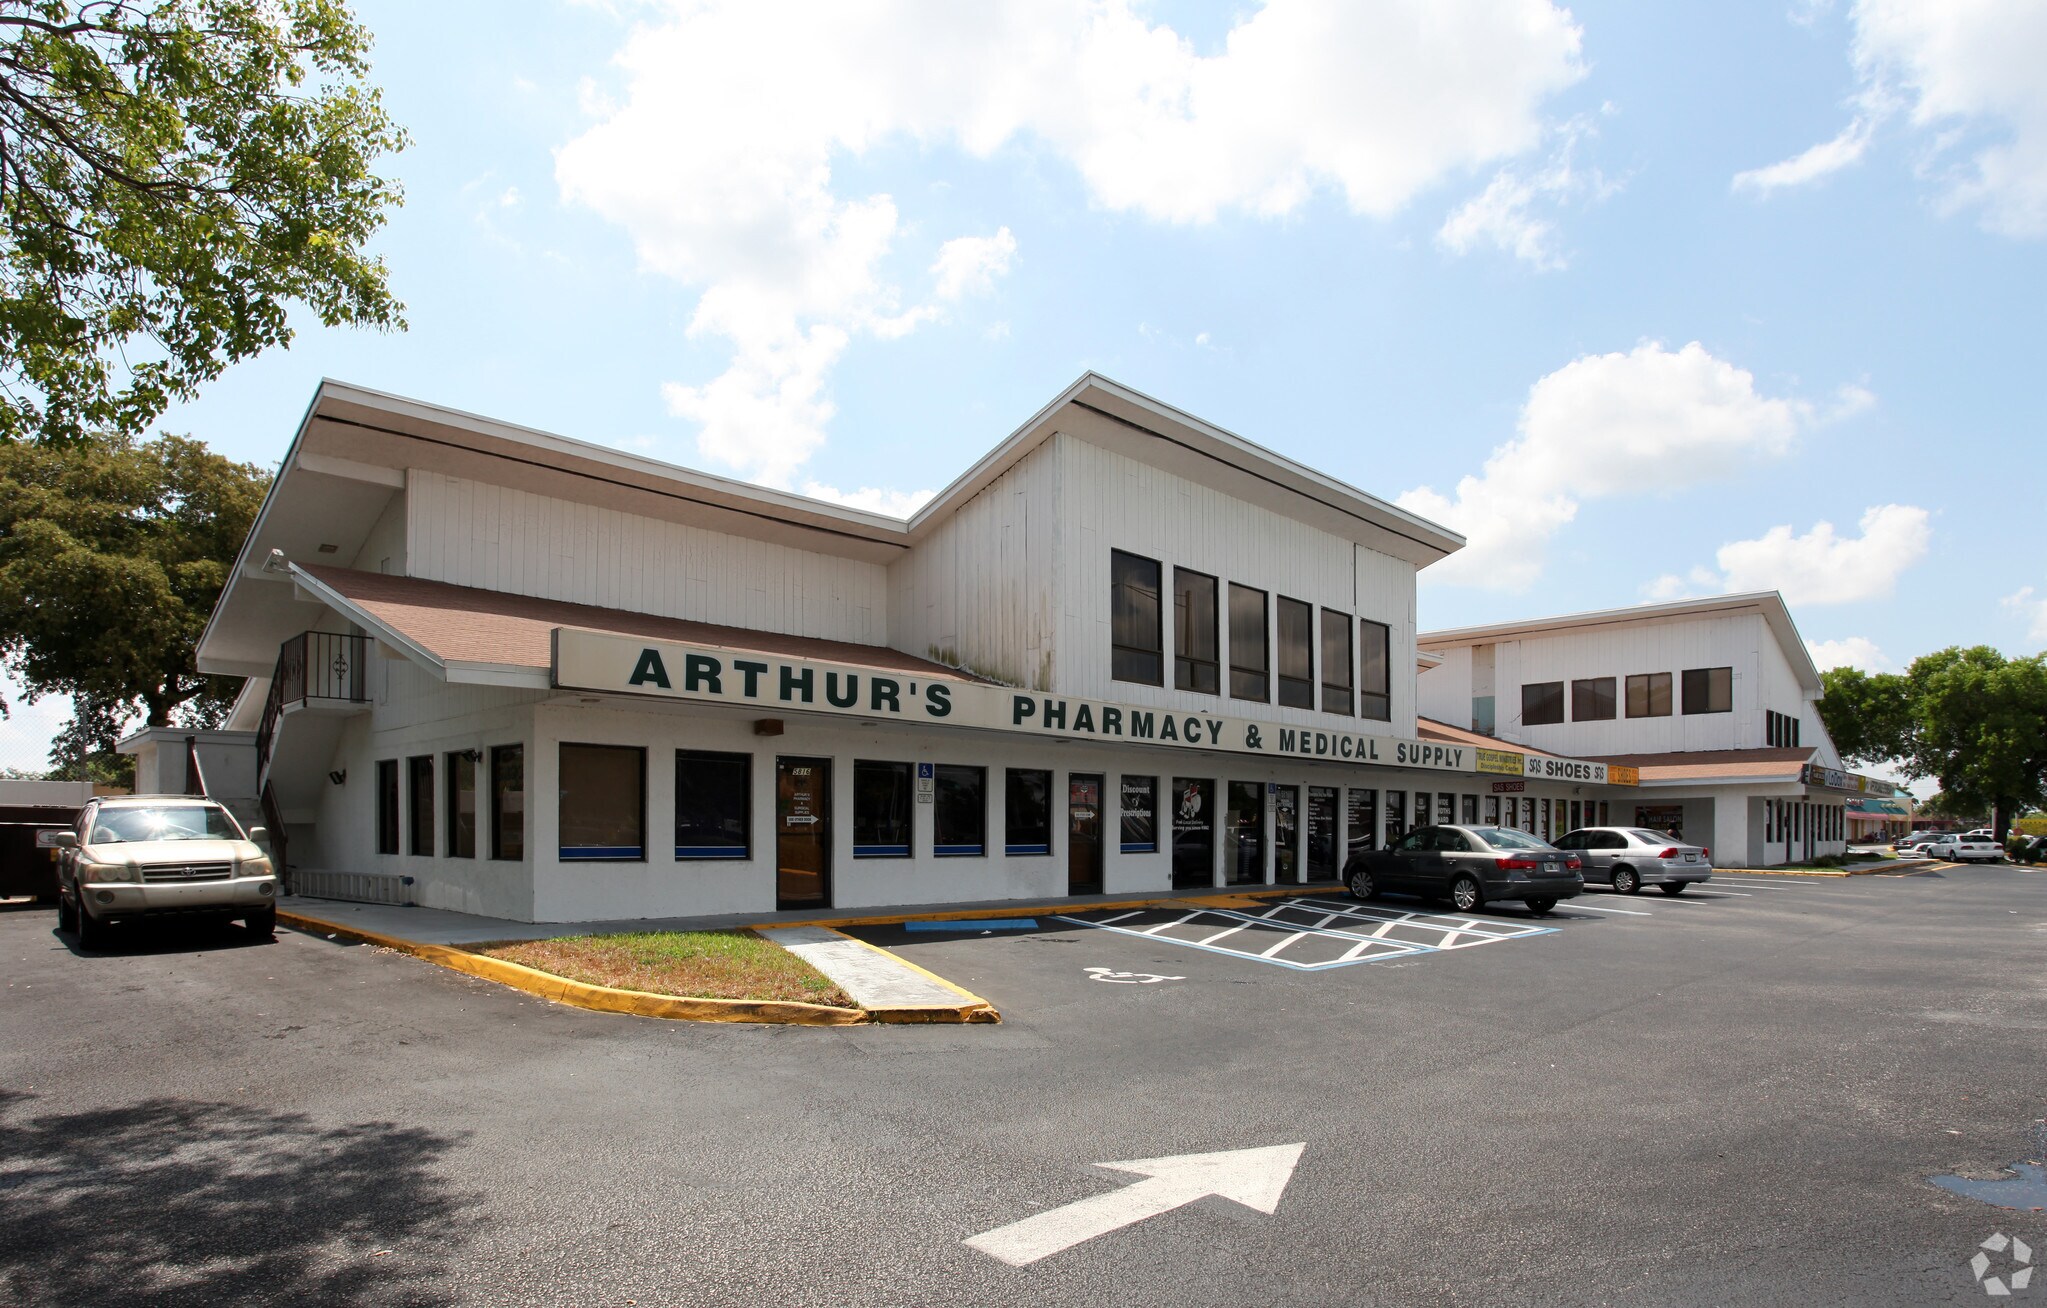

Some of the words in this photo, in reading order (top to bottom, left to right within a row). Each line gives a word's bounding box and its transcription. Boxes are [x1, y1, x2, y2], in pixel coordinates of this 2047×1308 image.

[628, 647, 953, 718] ARTHUR'S
[1012, 695, 1224, 746] PHARMACY
[1245, 724, 1263, 750] &
[1278, 728, 1380, 761] MEDICAL
[1396, 742, 1464, 768] SUPPLY
[1486, 753, 1499, 763] GOSPEL
[792, 767, 811, 775] 5816
[1545, 760, 1591, 780] SHOES
[1122, 784, 1150, 794] Discount
[1493, 783, 1505, 792] SAS
[1505, 782, 1524, 791] SHOES
[1120, 807, 1152, 819] Prescriptions
[1649, 815, 1661, 823] HAIR
[1663, 815, 1682, 823] SALON
